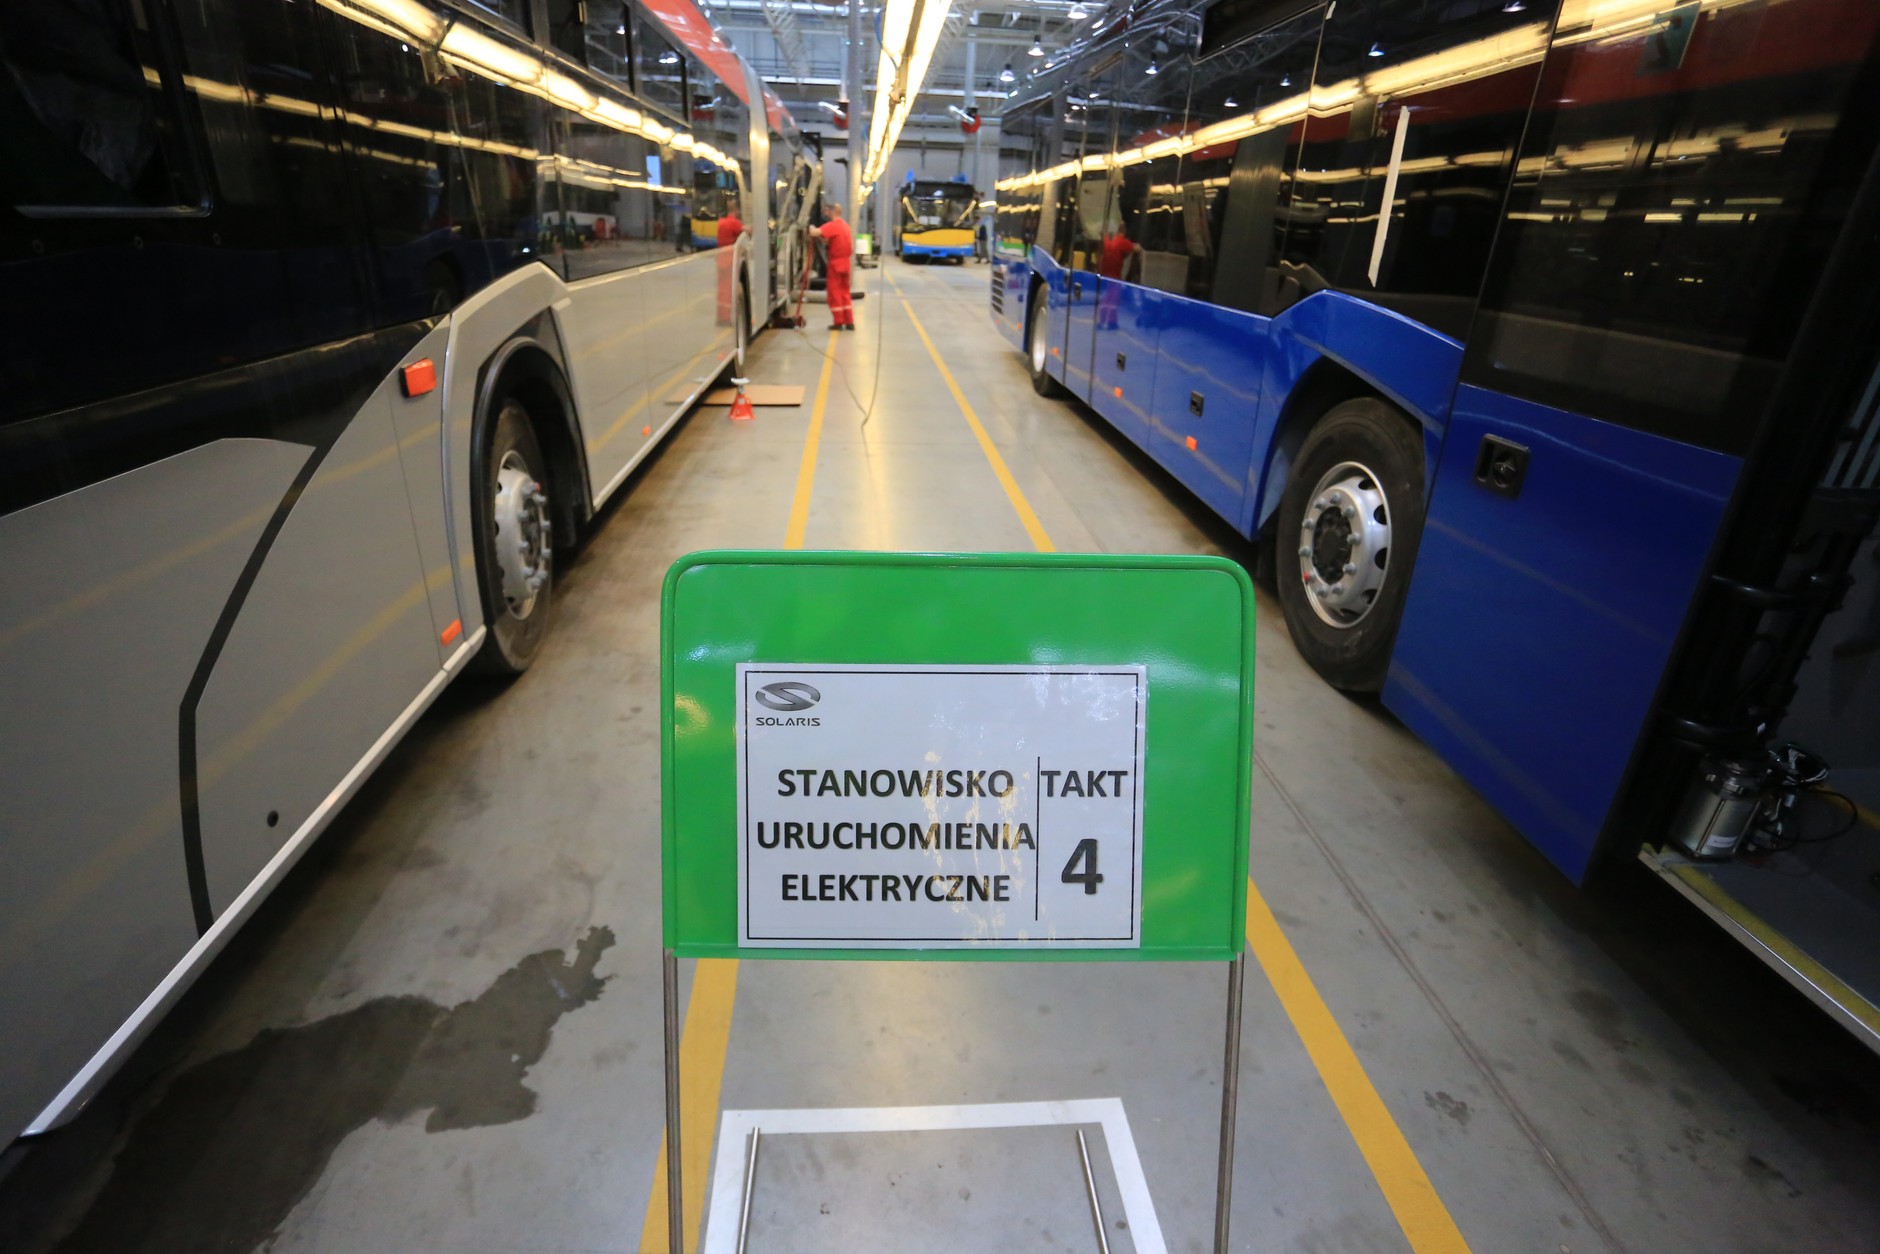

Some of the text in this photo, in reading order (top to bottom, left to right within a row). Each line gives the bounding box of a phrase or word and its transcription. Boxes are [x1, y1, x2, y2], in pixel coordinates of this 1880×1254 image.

[755, 717, 821, 727] SOLARIS
[777, 769, 1014, 798] STANOWISKO
[1040, 770, 1129, 798] TAKT
[756, 822, 1036, 850] URUCHOMIENIA
[1061, 838, 1104, 896] 4
[781, 874, 1011, 902] ELEKTRYCZNE
